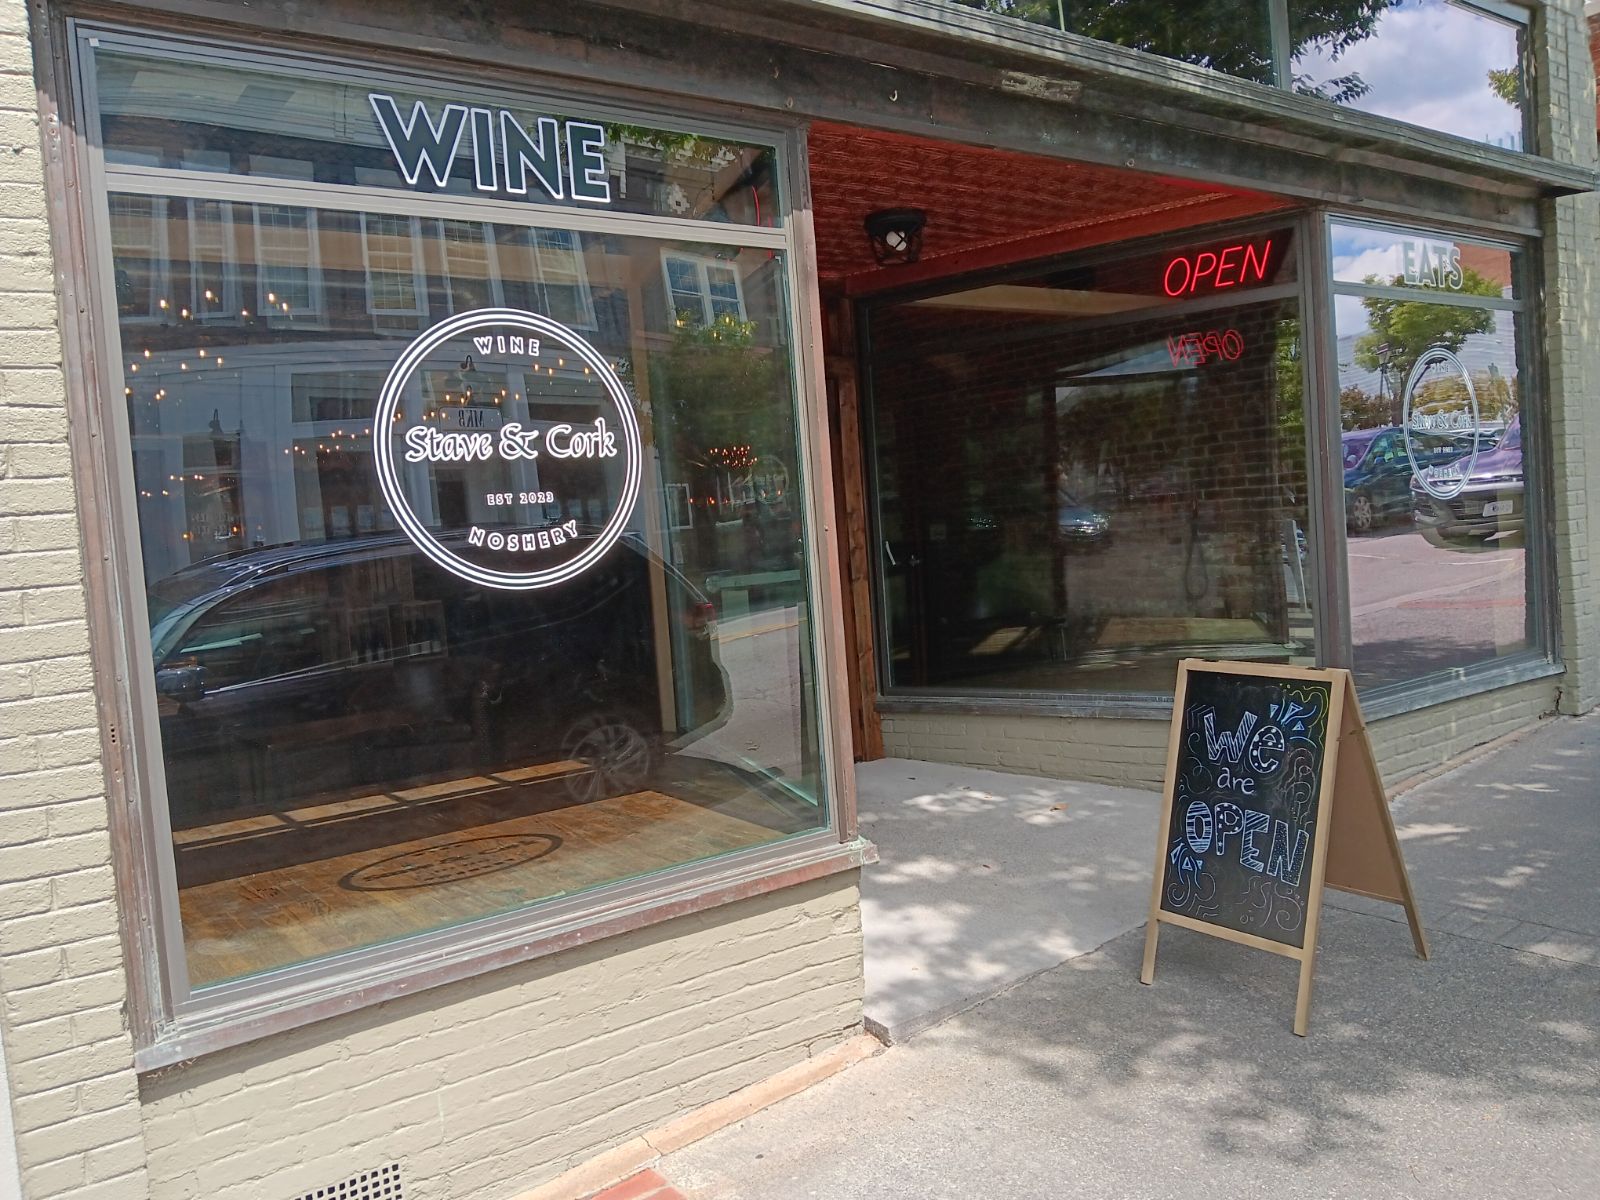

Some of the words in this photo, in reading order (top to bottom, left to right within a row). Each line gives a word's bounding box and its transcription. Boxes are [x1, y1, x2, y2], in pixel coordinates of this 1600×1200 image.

[368, 93, 611, 203] WINE
[1164, 239, 1273, 297] OPEN
[1402, 240, 1464, 290] EATS
[473, 335, 540, 356] WINE
[405, 425, 493, 462] Stave
[498, 422, 539, 460] &
[546, 416, 617, 458] Cork
[486, 492, 513, 506] EST
[519, 491, 555, 504] 2023
[468, 520, 578, 551] NOSHERY
[1203, 710, 1285, 774] We
[1217, 766, 1255, 796] are
[1185, 800, 1310, 887] OPEN
